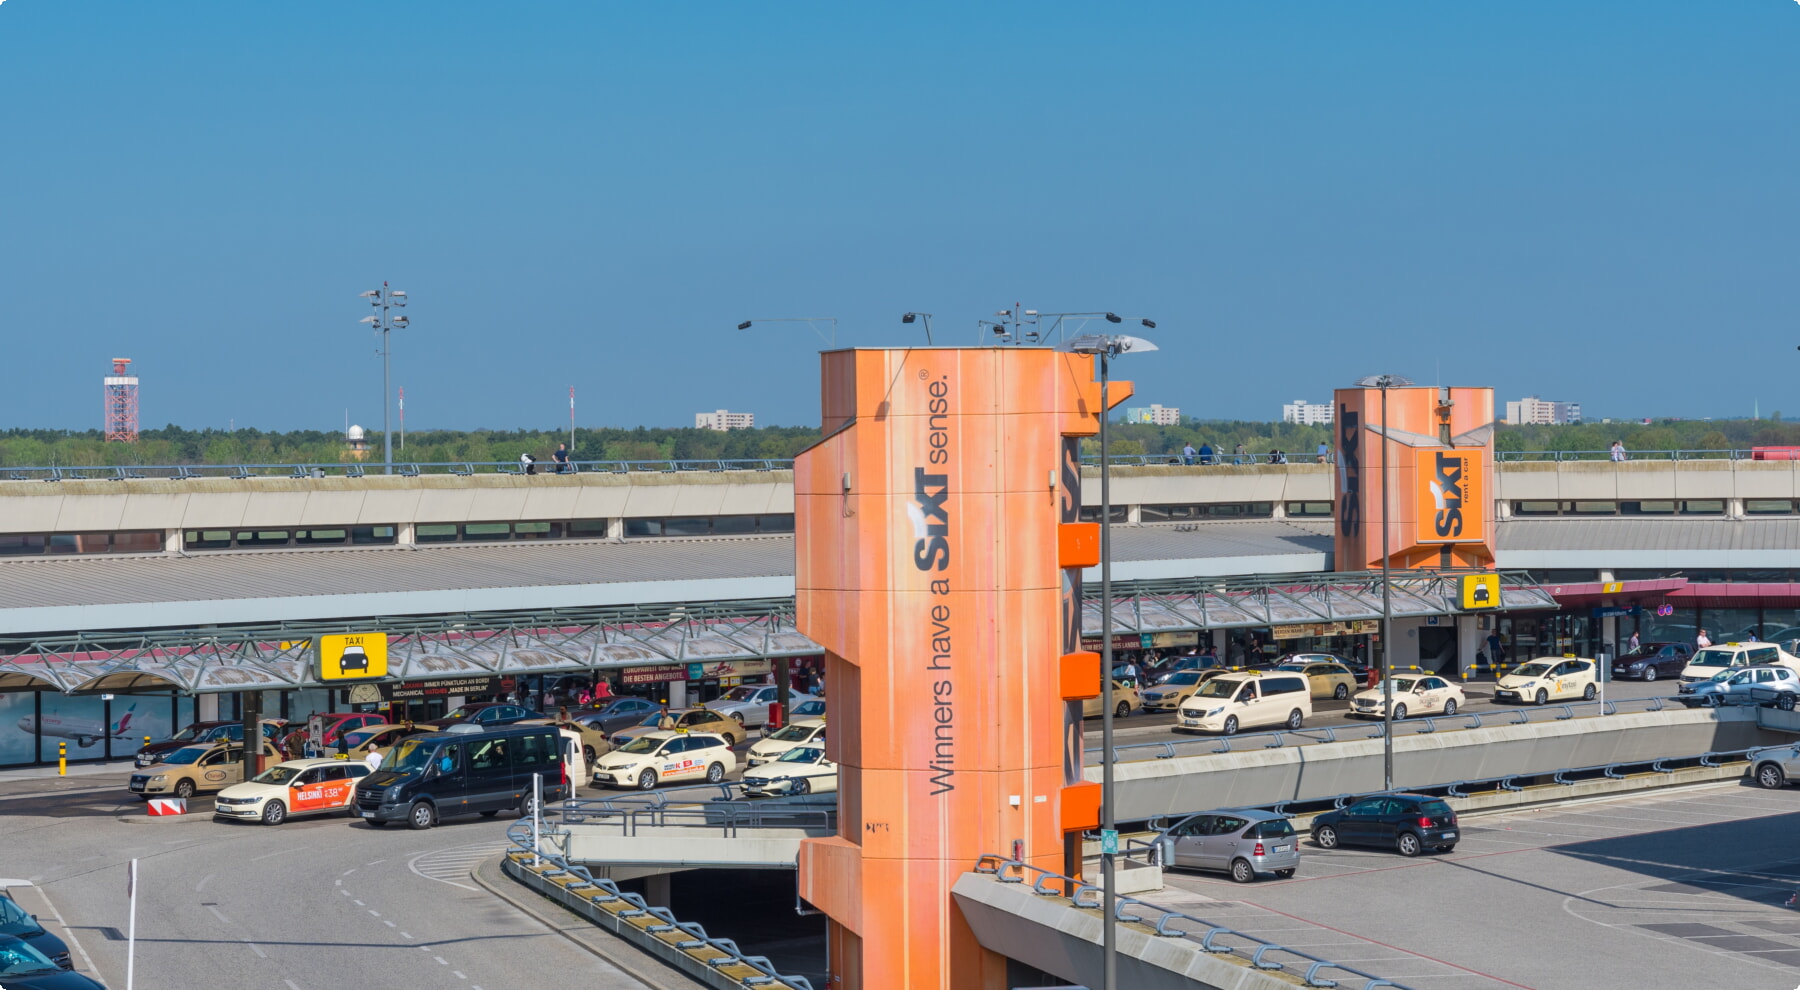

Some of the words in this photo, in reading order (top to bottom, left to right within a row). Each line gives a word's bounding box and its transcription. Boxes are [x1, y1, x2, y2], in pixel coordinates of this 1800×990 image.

[929, 375, 949, 465] sense.
[931, 578, 951, 596] a
[344, 636, 364, 645] TAXI
[927, 605, 951, 670] have
[440, 678, 467, 687] PÜNKTLICH
[623, 675, 633, 683] DIE
[633, 674, 654, 682] BESTEN
[654, 671, 685, 681] ANGEBOTE.
[929, 680, 955, 796] Winners
[297, 790, 323, 800] HELSINKI
